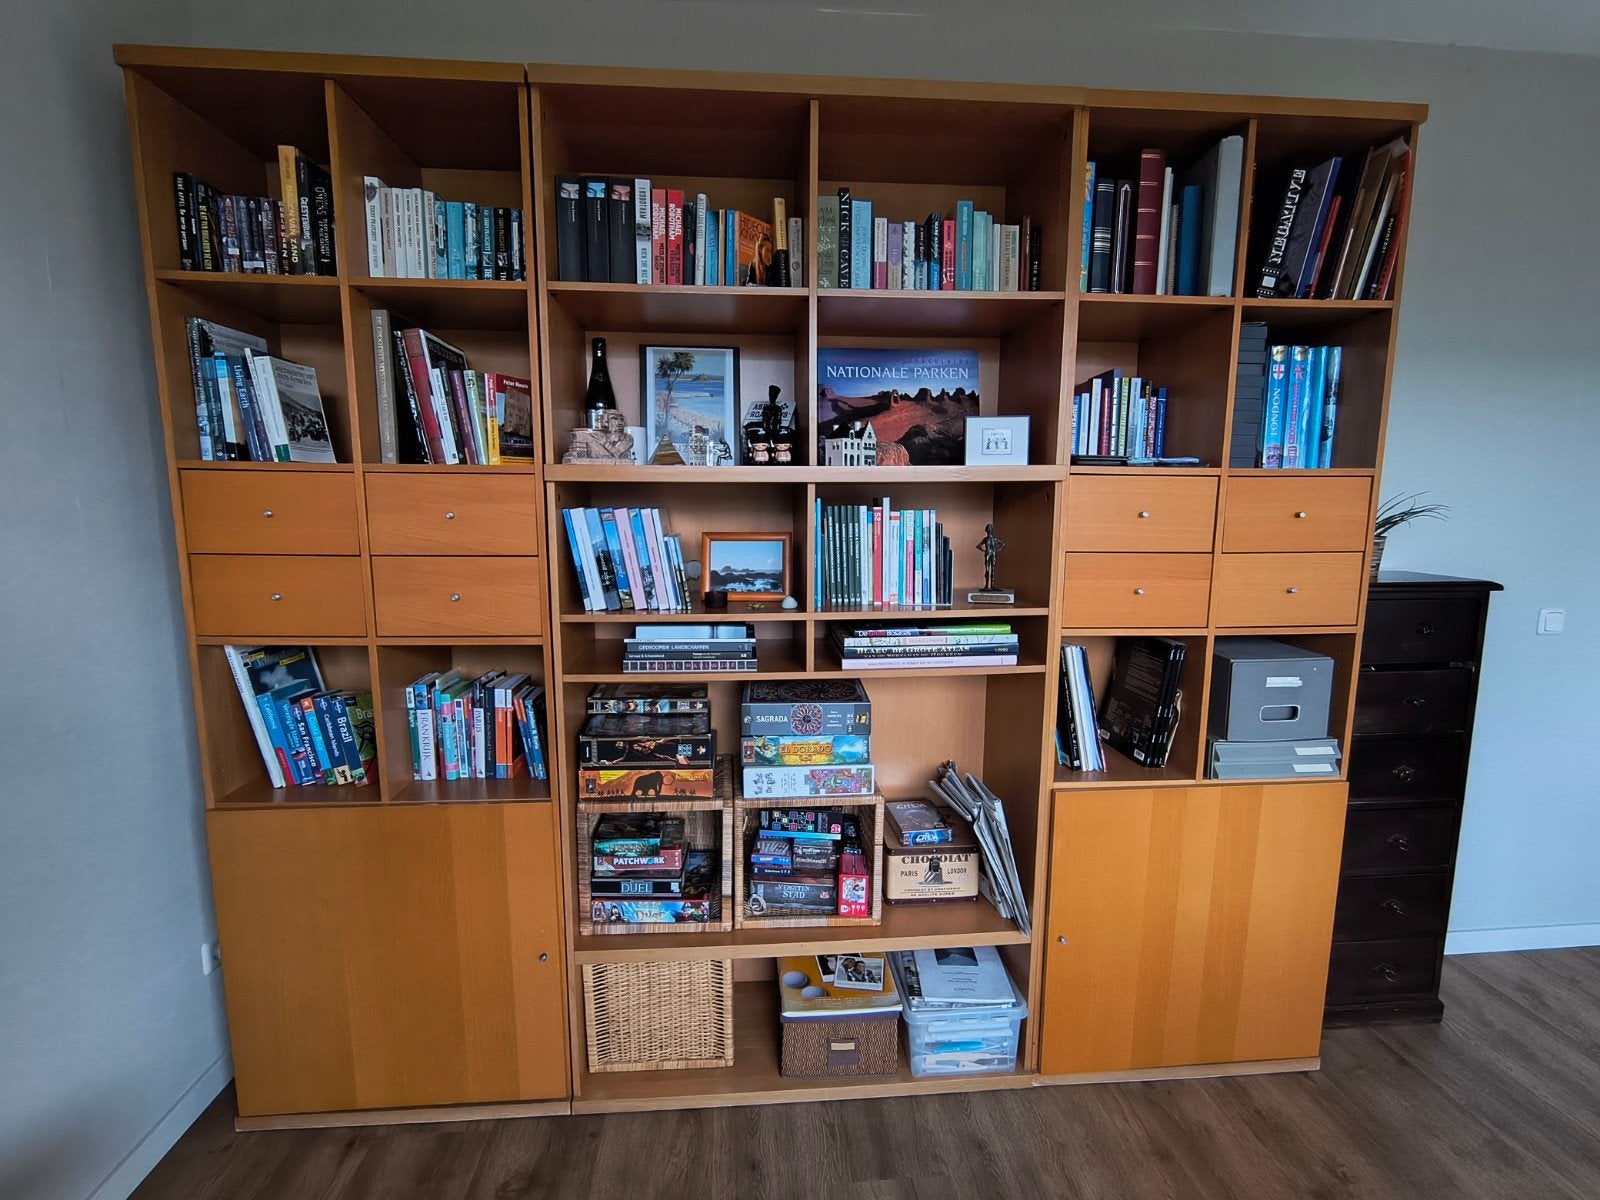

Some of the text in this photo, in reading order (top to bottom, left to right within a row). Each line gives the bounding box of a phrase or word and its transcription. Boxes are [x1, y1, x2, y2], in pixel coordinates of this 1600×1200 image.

[638, 190, 648, 219] ROBOTHAM
[668, 203, 676, 240] ROBOTHAM
[290, 238, 298, 262] ZAND
[840, 192, 850, 288] NICK CAVE
[827, 366, 969, 380] NATIONALE PARKEN
[234, 365, 249, 408] Living Earth
[1270, 388, 1281, 436] LONDON
[874, 512, 881, 522] 52
[282, 703, 301, 748] Verenigde Staten
[336, 716, 352, 743] Brazil
[528, 710, 536, 729] Jordan
[756, 715, 788, 723] SAGRADA
[297, 722, 316, 768] San Francisco
[308, 716, 324, 751] Costa Rica
[324, 714, 339, 758] Caribbean Islands
[420, 712, 432, 762] FRANKRIJK
[779, 743, 832, 754] EL DORADO
[613, 857, 665, 865] PATCHWORK
[901, 854, 971, 864] CHOOLAT
[900, 870, 918, 878] PARIS
[621, 883, 653, 893] DUEL
[782, 890, 805, 900] STAD
